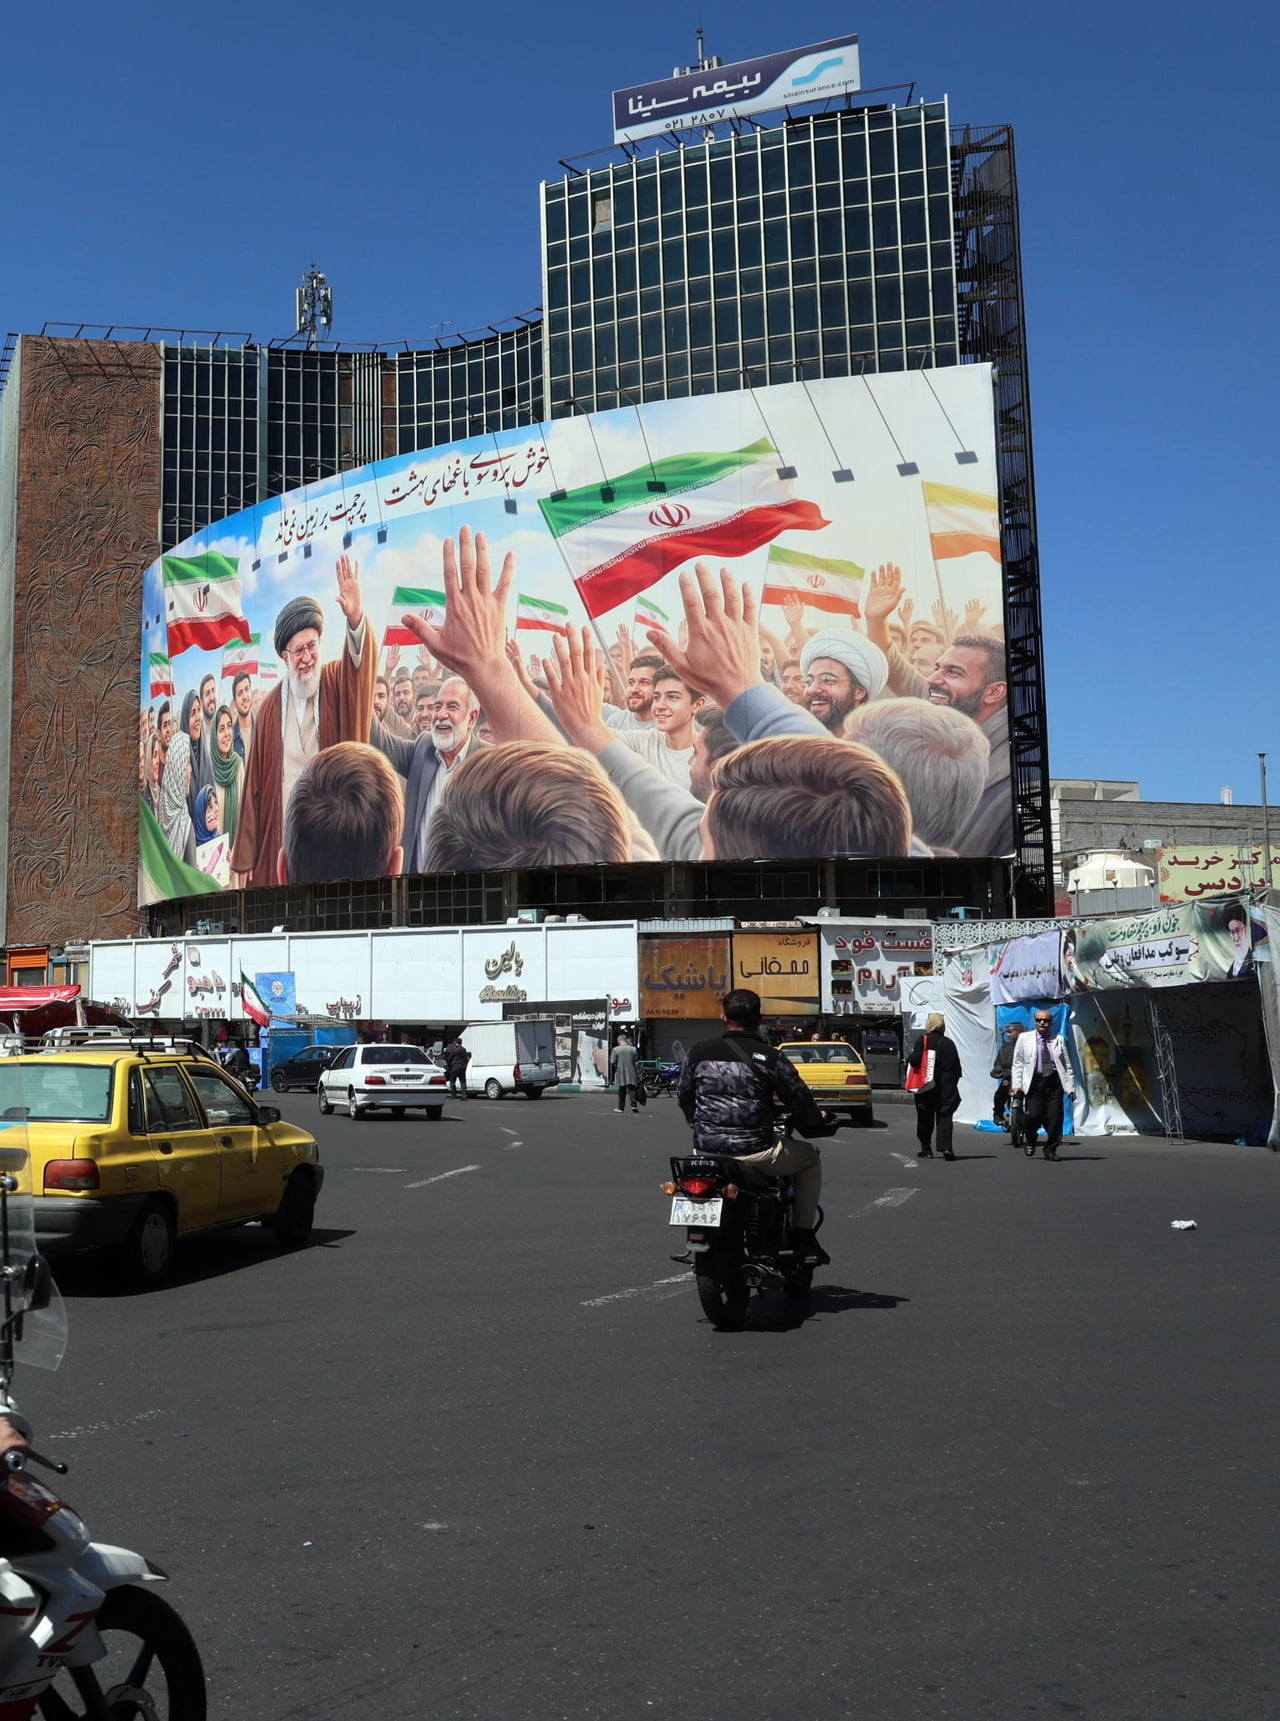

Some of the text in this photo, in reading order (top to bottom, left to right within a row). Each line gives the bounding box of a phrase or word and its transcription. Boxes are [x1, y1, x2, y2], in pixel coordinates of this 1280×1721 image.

[628, 72, 761, 117] بیمه سینا
[783, 79, 855, 99] sinainsurance.com
[1168, 851, 1223, 870] خرید
[778, 937, 811, 948] فروشگاه
[835, 930, 933, 954] فست فود
